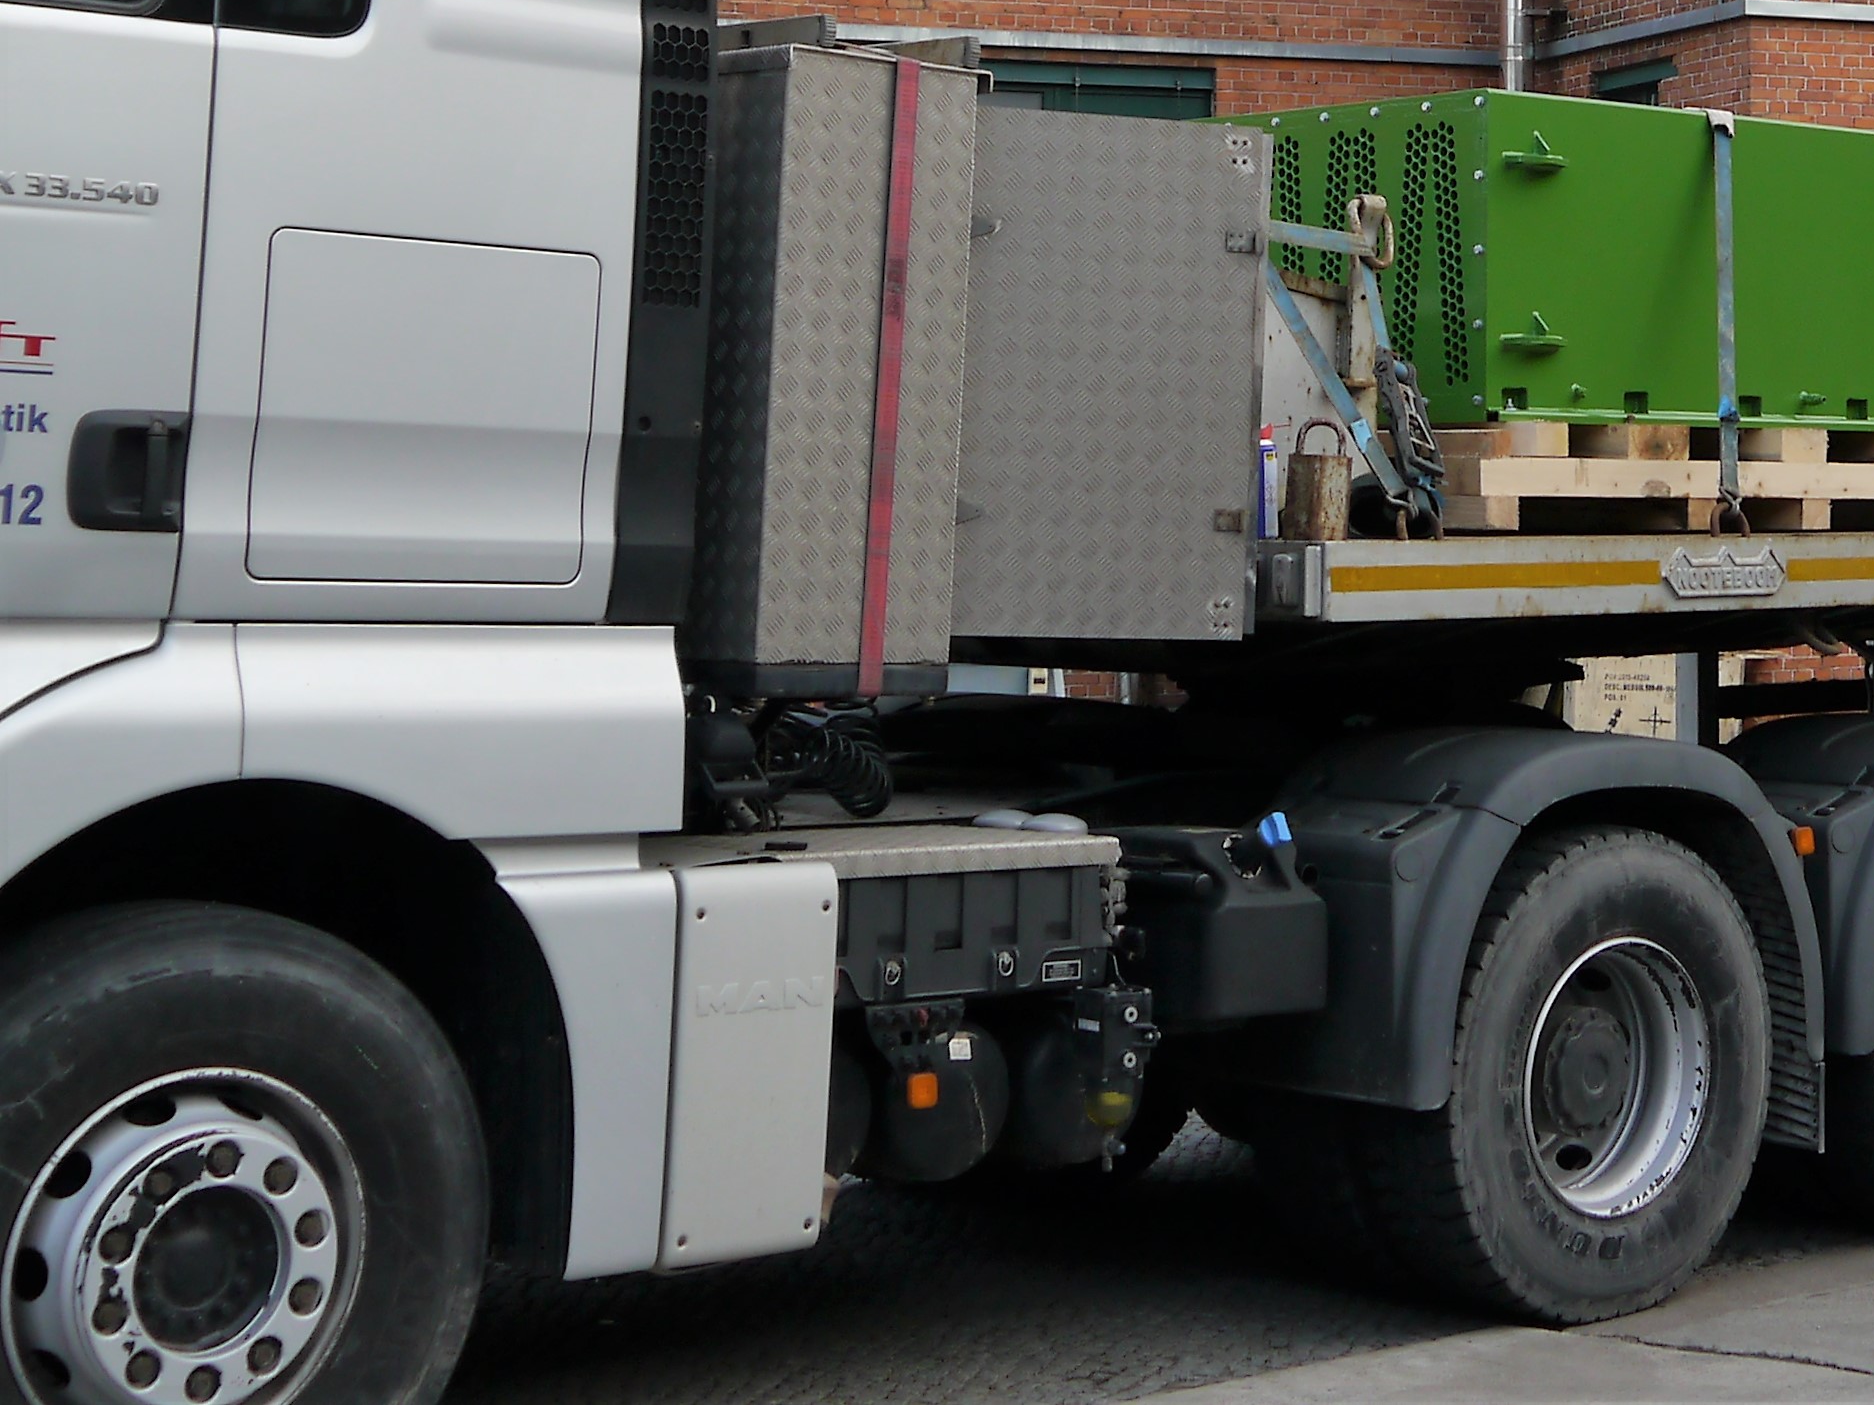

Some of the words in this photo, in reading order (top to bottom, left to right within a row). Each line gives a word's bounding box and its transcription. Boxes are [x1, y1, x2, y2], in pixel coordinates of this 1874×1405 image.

[24, 172, 159, 206] 33.540
[1676, 565, 1779, 591] NOOTEBOOM
[696, 975, 825, 1018] MAN
